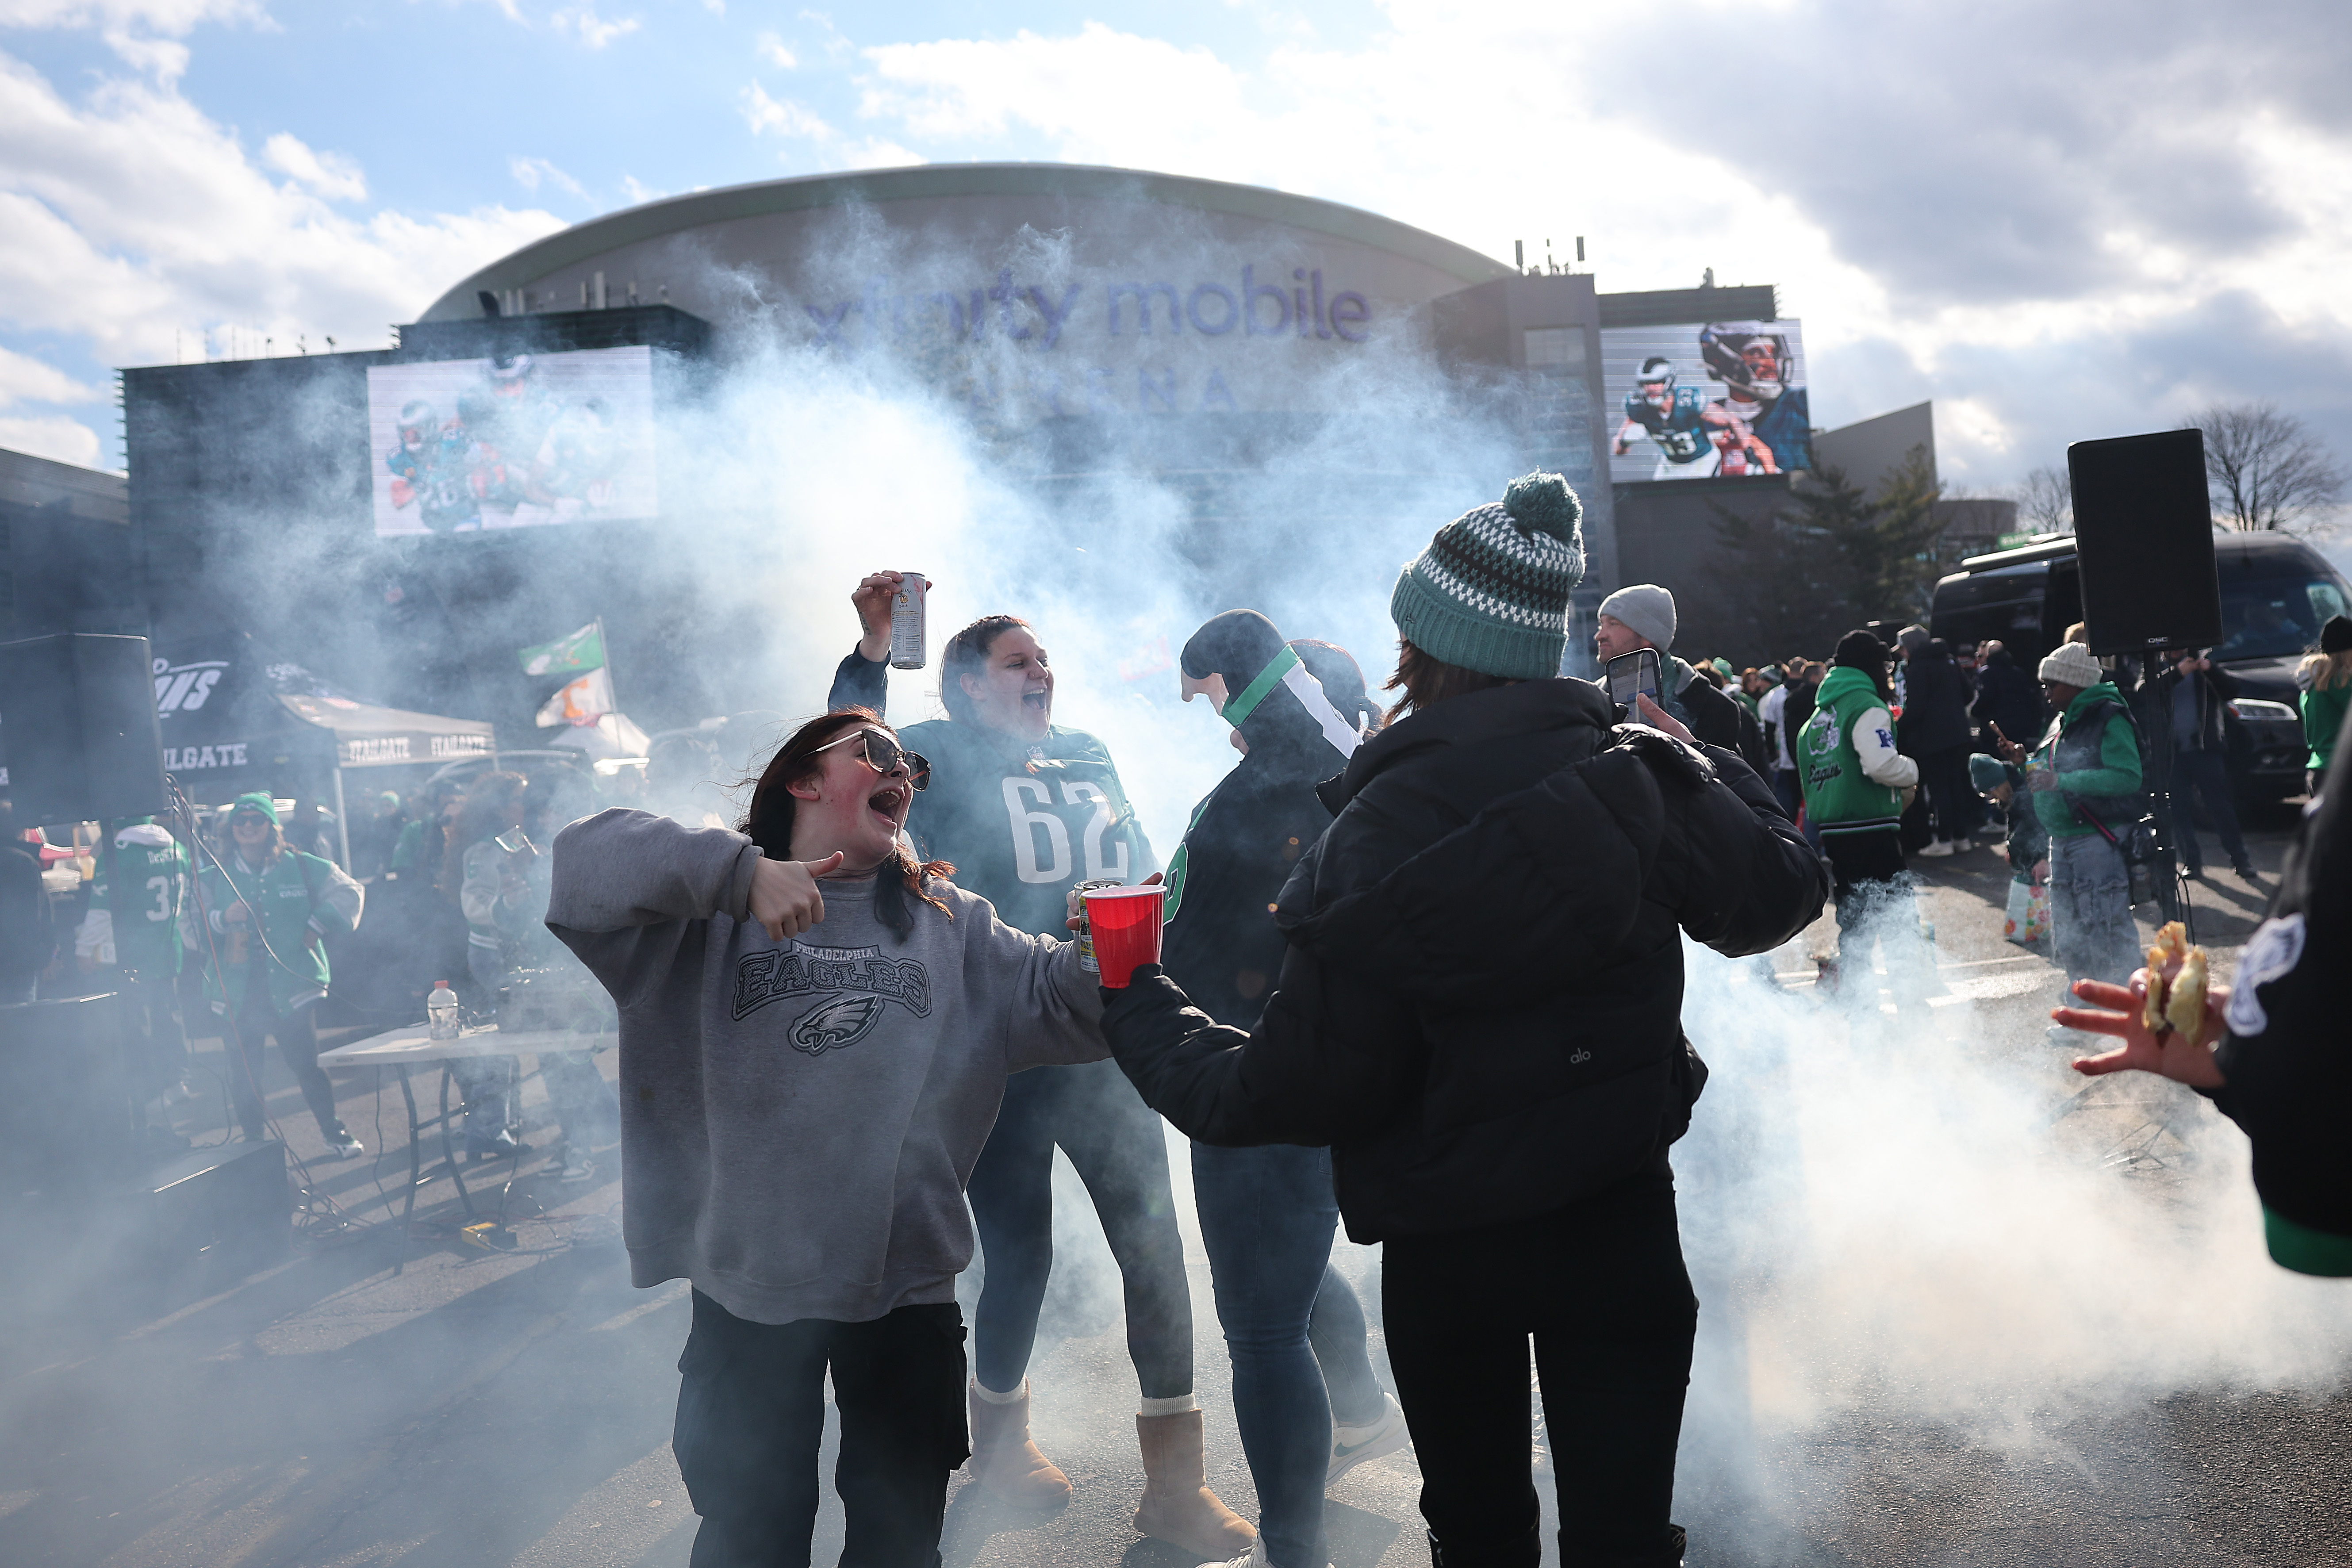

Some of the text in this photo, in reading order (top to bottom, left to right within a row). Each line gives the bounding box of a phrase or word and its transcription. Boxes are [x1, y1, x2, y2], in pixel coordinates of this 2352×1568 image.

[1107, 265, 1370, 343] mobile
[1002, 777, 1128, 883] 62
[796, 942, 875, 961] PHILADELPHIA
[736, 954, 929, 1016] EAGLES
[1571, 1047, 1591, 1064] alo
